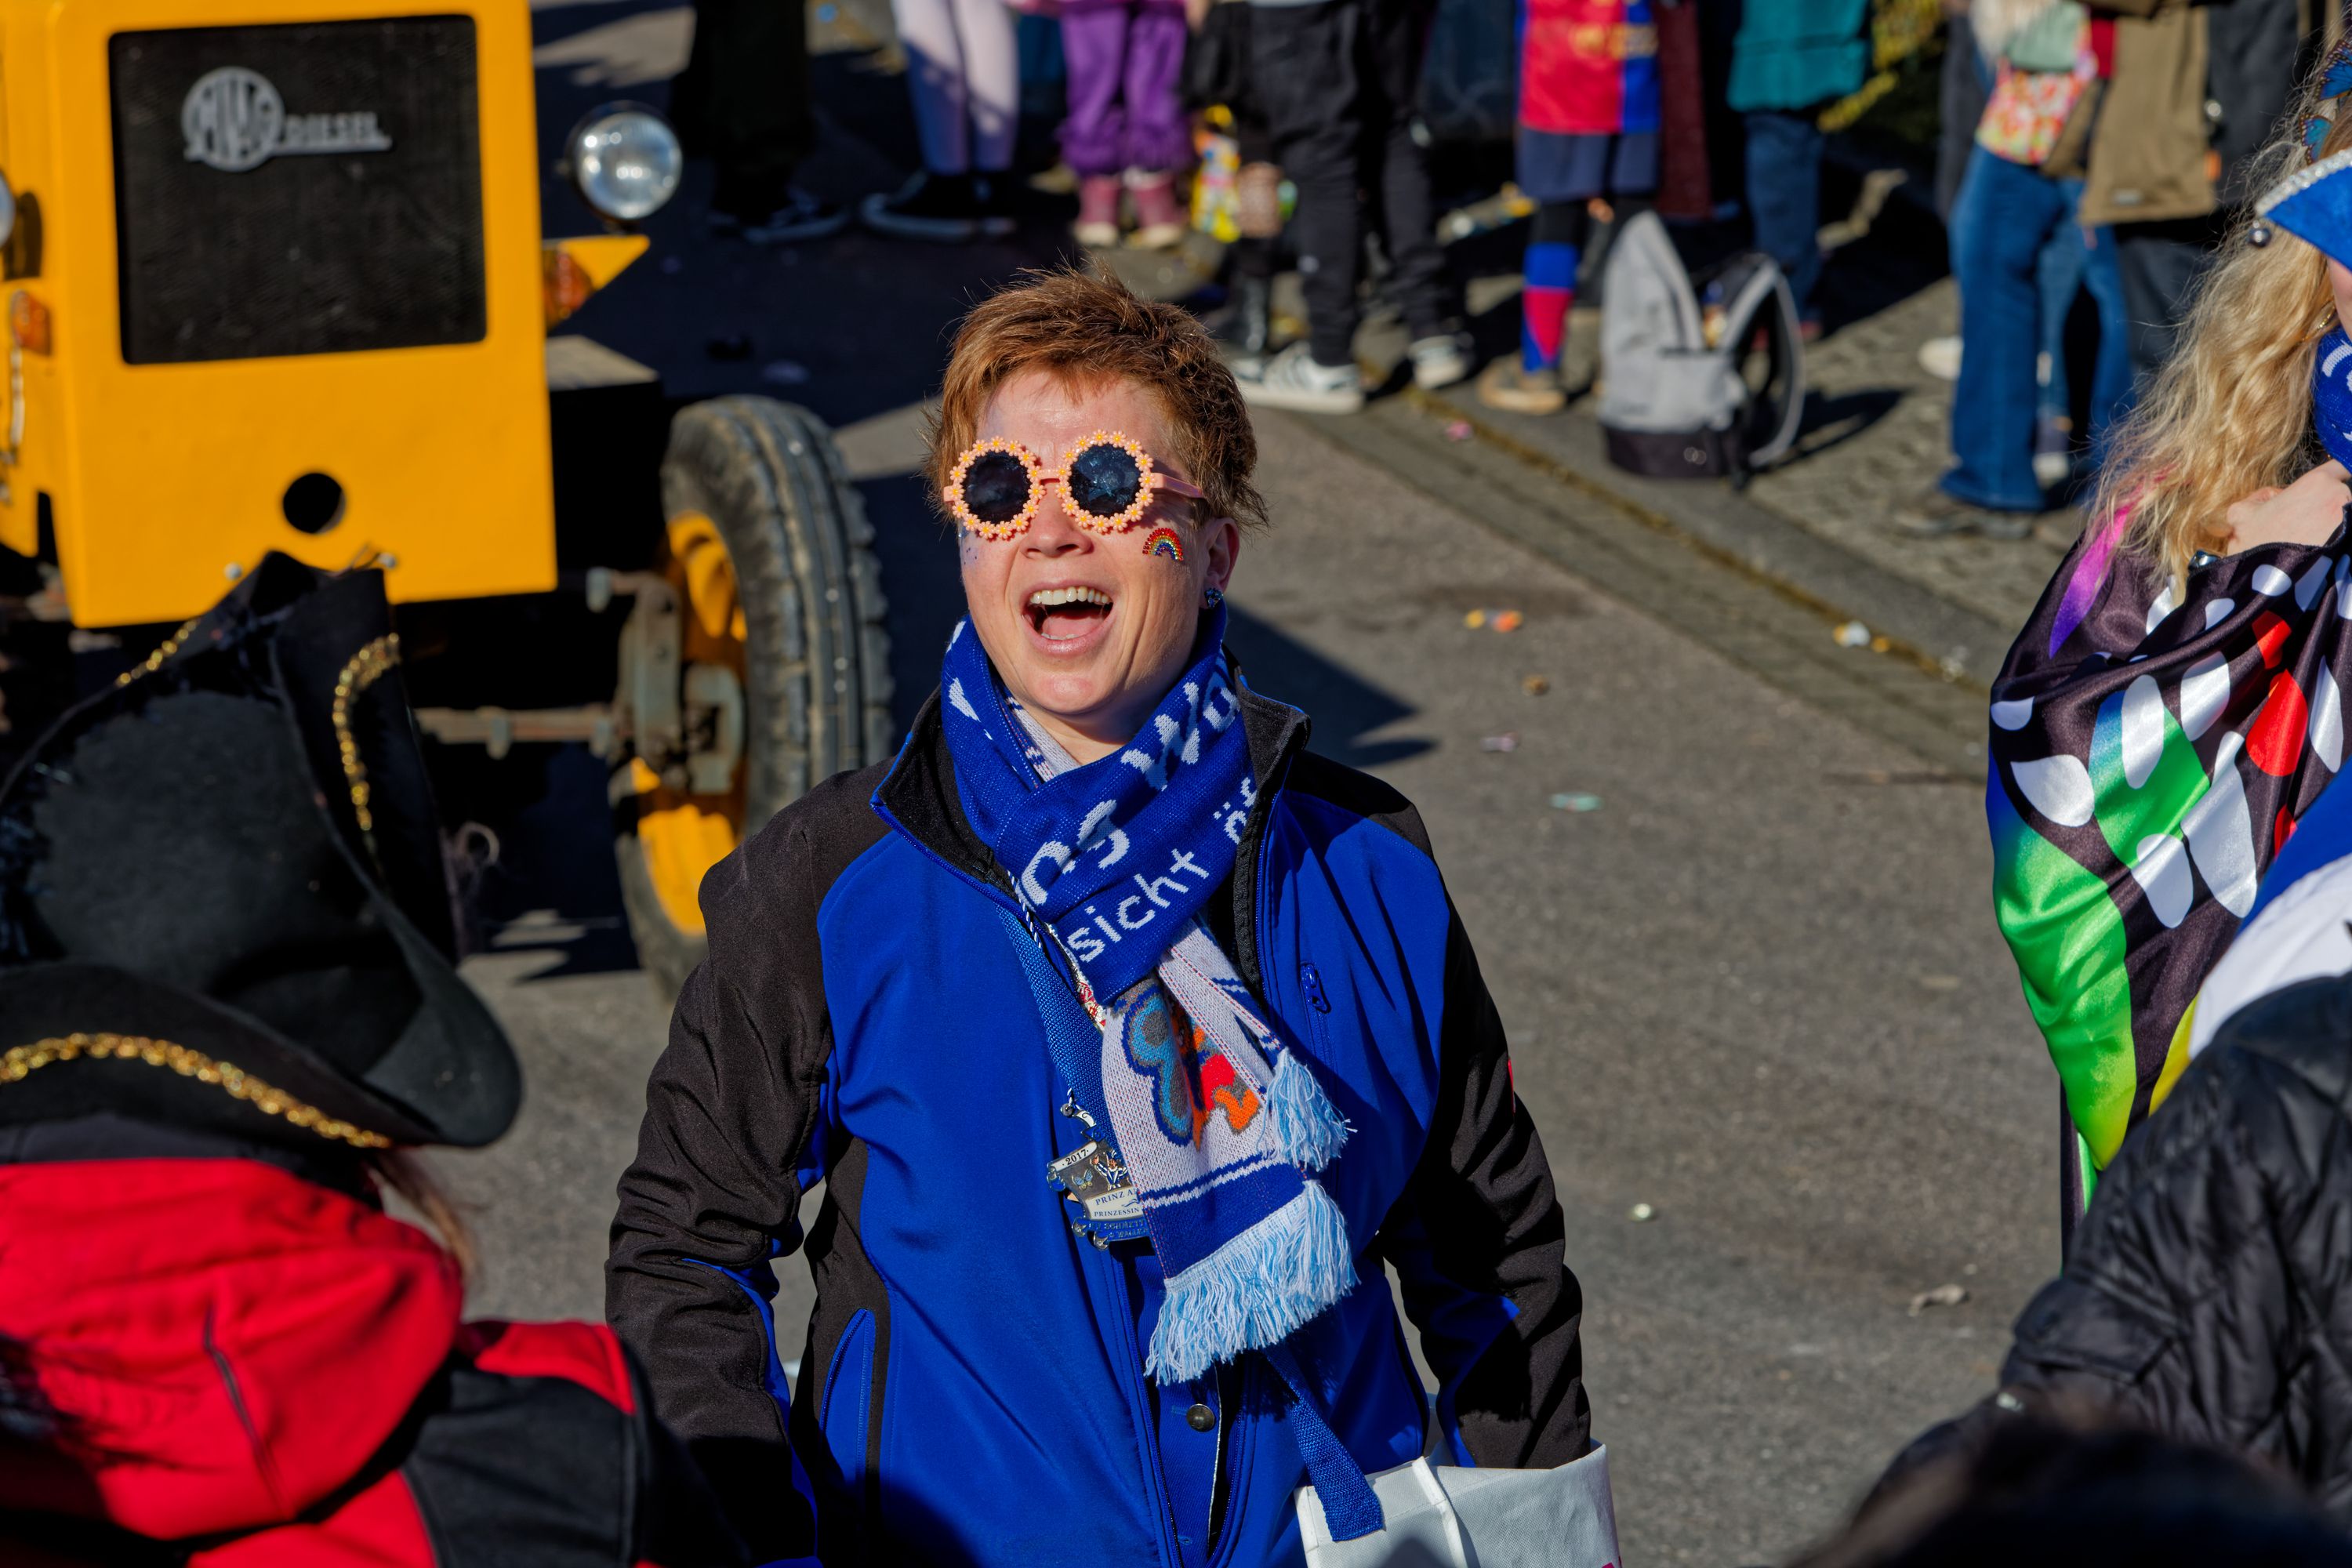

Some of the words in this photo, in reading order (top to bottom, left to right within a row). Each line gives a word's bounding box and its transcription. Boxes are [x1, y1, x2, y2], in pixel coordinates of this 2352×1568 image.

[1067, 848, 1209, 963] sicht
[1065, 1149, 1087, 1166] 2017
[1095, 1191, 1125, 1206] PRINZ
[1094, 1207, 1140, 1218] PRINZESSIN
